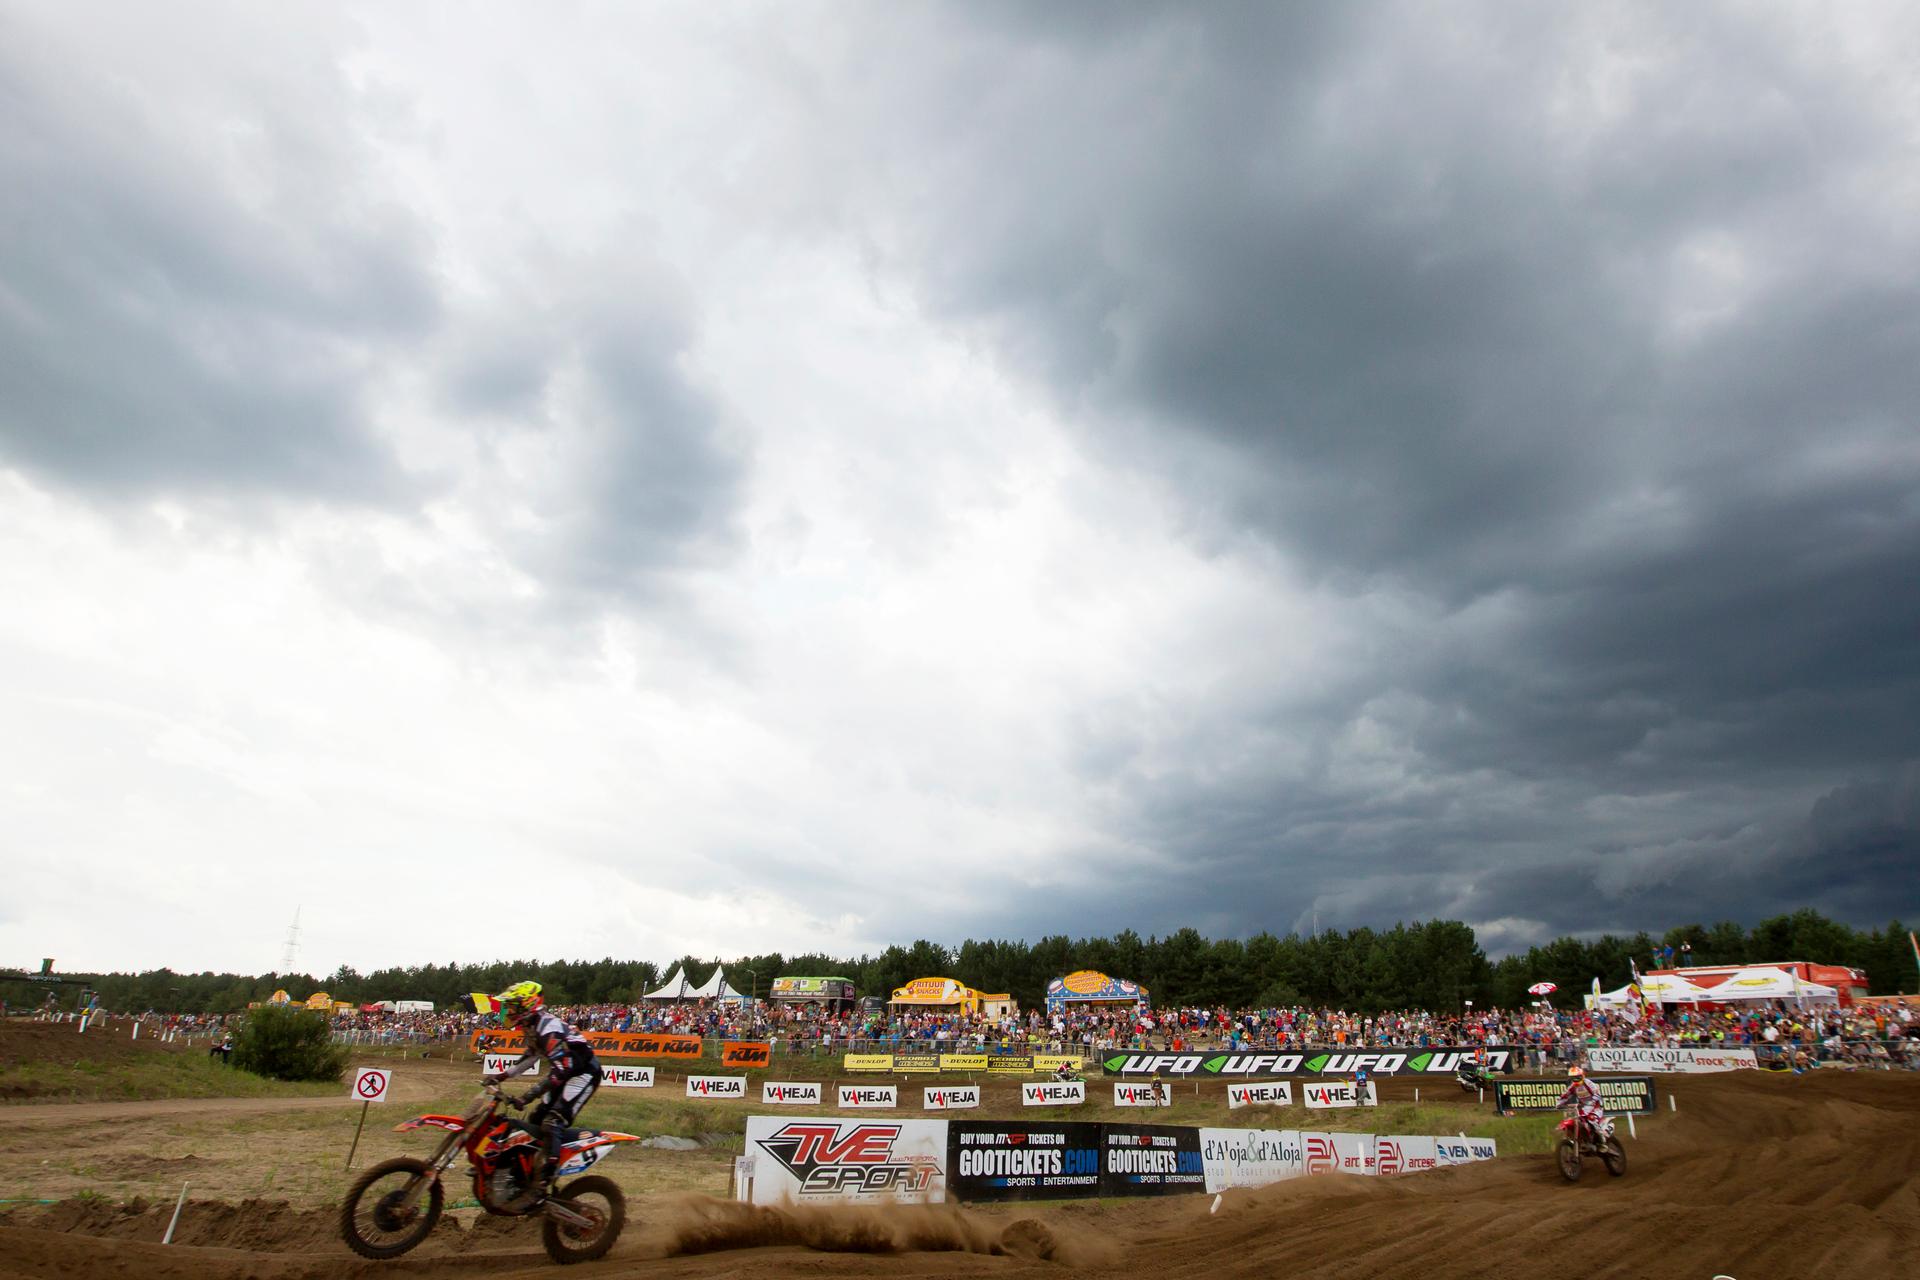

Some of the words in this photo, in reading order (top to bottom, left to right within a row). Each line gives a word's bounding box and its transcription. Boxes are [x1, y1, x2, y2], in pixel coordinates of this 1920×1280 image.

[622, 1038, 659, 1053] KTM
[662, 1039, 699, 1053] KTM
[727, 1047, 768, 1062] KTM
[1590, 1050, 1640, 1062] CASOLA
[1640, 1051, 1695, 1063] CASOLA
[488, 1057, 535, 1072] VAH
[1121, 1055, 1203, 1072] UFO
[1221, 1055, 1305, 1073] UFO
[1322, 1053, 1407, 1072] UFO
[601, 1069, 649, 1083] VAHEJA
[690, 1079, 741, 1094] VAHEJA
[767, 1086, 816, 1101] VAHEJA
[1026, 1086, 1080, 1102] VAHEJA
[1502, 1084, 1567, 1096] PARMIGIANO
[1597, 1082, 1648, 1096] MIGIANO
[842, 1089, 892, 1104] VAHEJA
[927, 1090, 976, 1106] VAHEJA
[1232, 1087, 1287, 1105] VAHEJA
[1602, 1096, 1643, 1110] GGIANO
[779, 1126, 898, 1164] TVE
[960, 1133, 974, 1145] BUY
[976, 1133, 995, 1145] YOUR
[1028, 1133, 1054, 1144] TICKETS
[1056, 1133, 1065, 1144] ON
[1108, 1134, 1118, 1145] BUY
[1119, 1135, 1130, 1145] YOUR
[1152, 1136, 1169, 1147] TICKETS
[1170, 1137, 1177, 1147] ON
[959, 1148, 1098, 1176] GOOTICKETS.COM
[1108, 1149, 1203, 1174] GOOTICKETS.COM
[1345, 1157, 1375, 1168] arcse
[1408, 1157, 1436, 1168] arcese
[803, 1165, 943, 1192] SPORT
[1007, 1177, 1036, 1187] SPORTS
[1043, 1175, 1098, 1186] ENTERTAINMENT
[1140, 1174, 1160, 1184] SPORTS
[1165, 1175, 1204, 1183] ENTERTAINMENT
